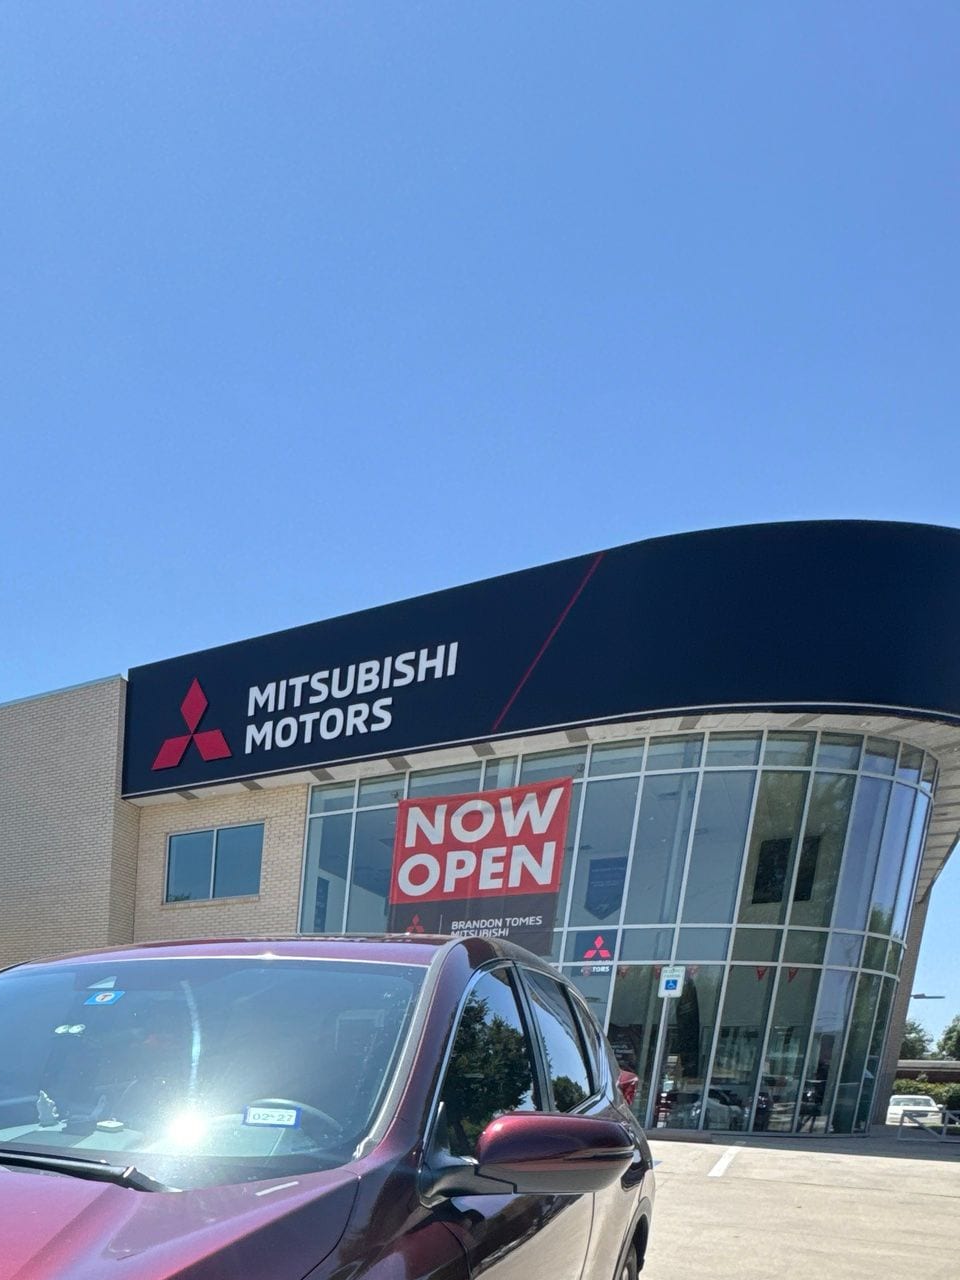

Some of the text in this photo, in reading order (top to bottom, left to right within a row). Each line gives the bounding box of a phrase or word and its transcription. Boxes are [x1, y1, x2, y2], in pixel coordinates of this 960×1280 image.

[247, 641, 459, 717] MITSUBISHI
[244, 696, 393, 754] MOTORS
[405, 787, 564, 848] NOW
[397, 841, 557, 897] OPEN
[450, 927, 510, 938] MITSUBISHI
[451, 915, 543, 930] BRANDON TOMES
